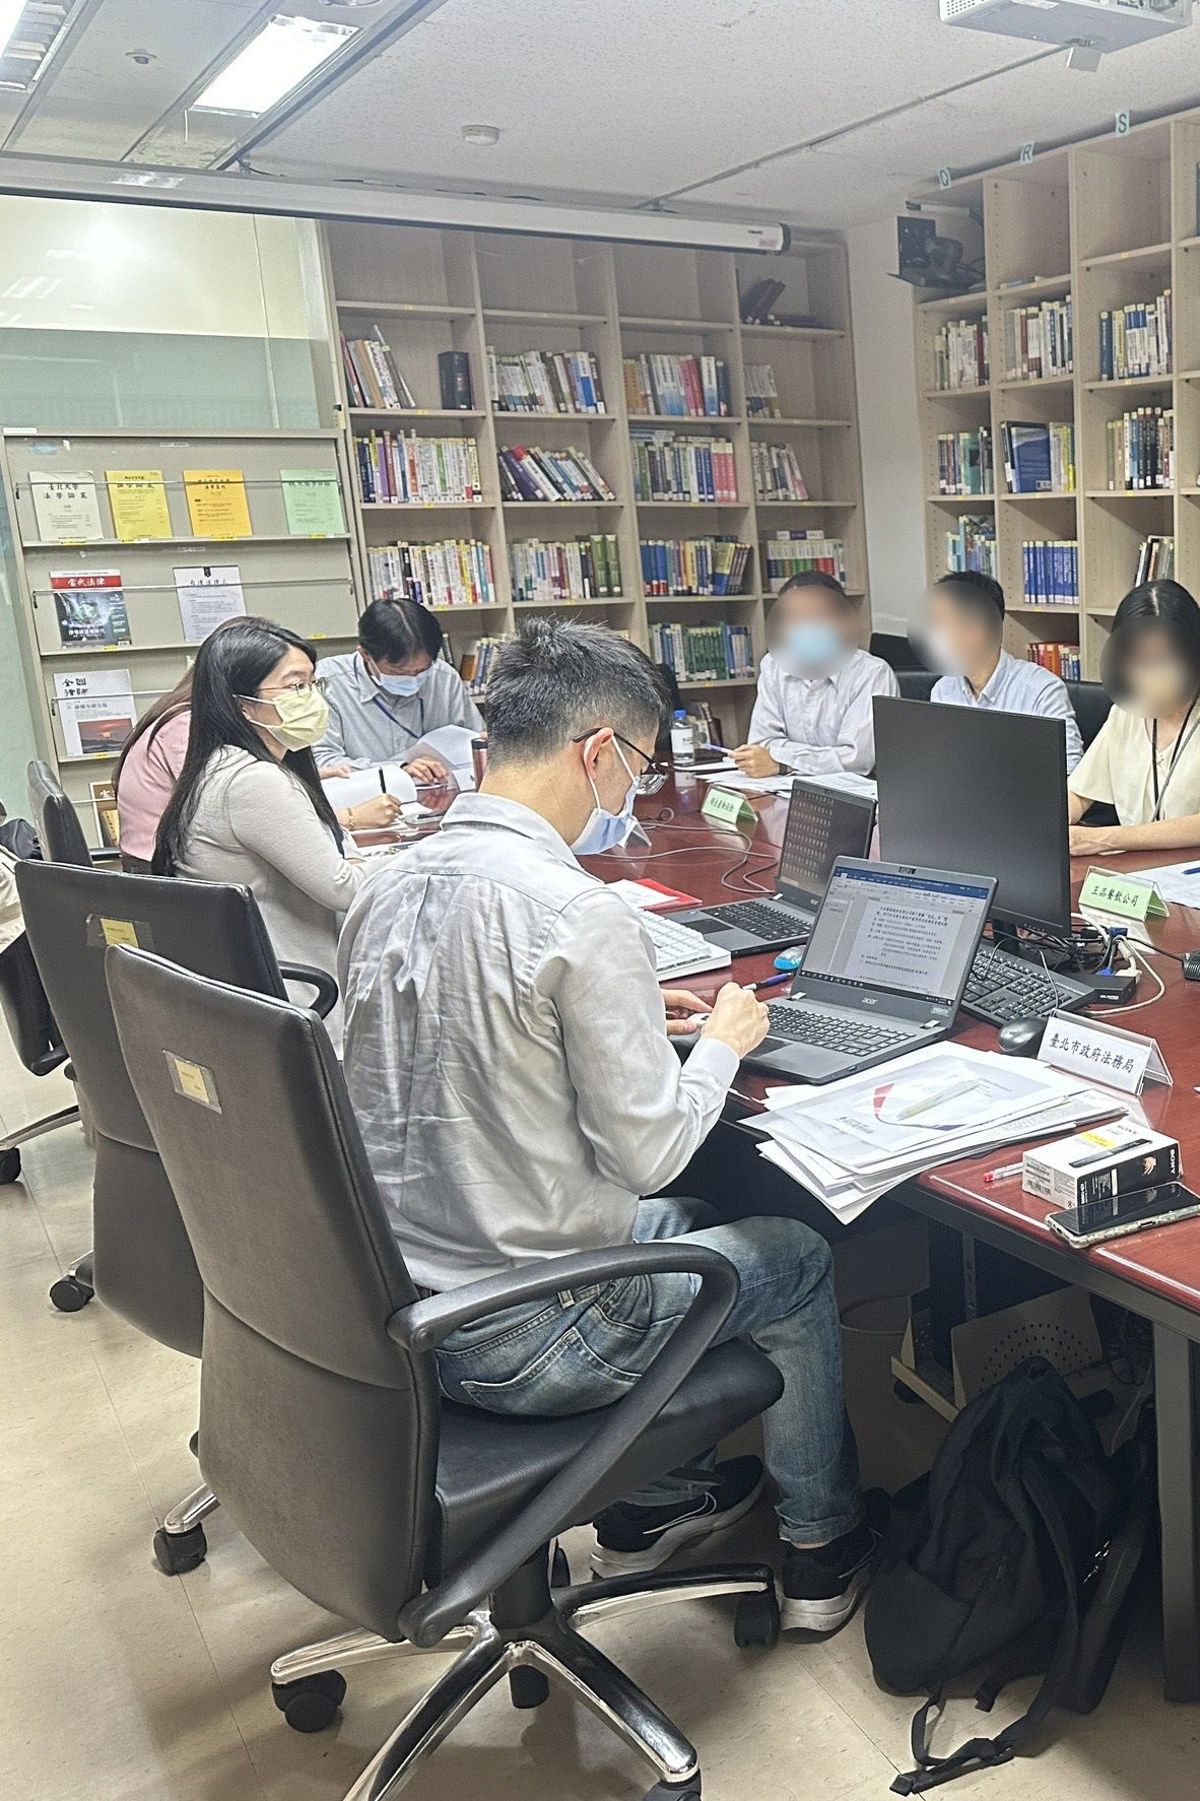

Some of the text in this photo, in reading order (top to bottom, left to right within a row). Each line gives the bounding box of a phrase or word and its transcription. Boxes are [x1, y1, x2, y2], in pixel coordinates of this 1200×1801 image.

[1118, 113, 1128, 133] S
[1022, 144, 1032, 161] R
[939, 169, 949, 187] Q
[67, 578, 106, 587] 當代法律
[1090, 885, 1139, 908] 王品餐飲公司
[1050, 1033, 1135, 1075] 臺北市政府法務局
